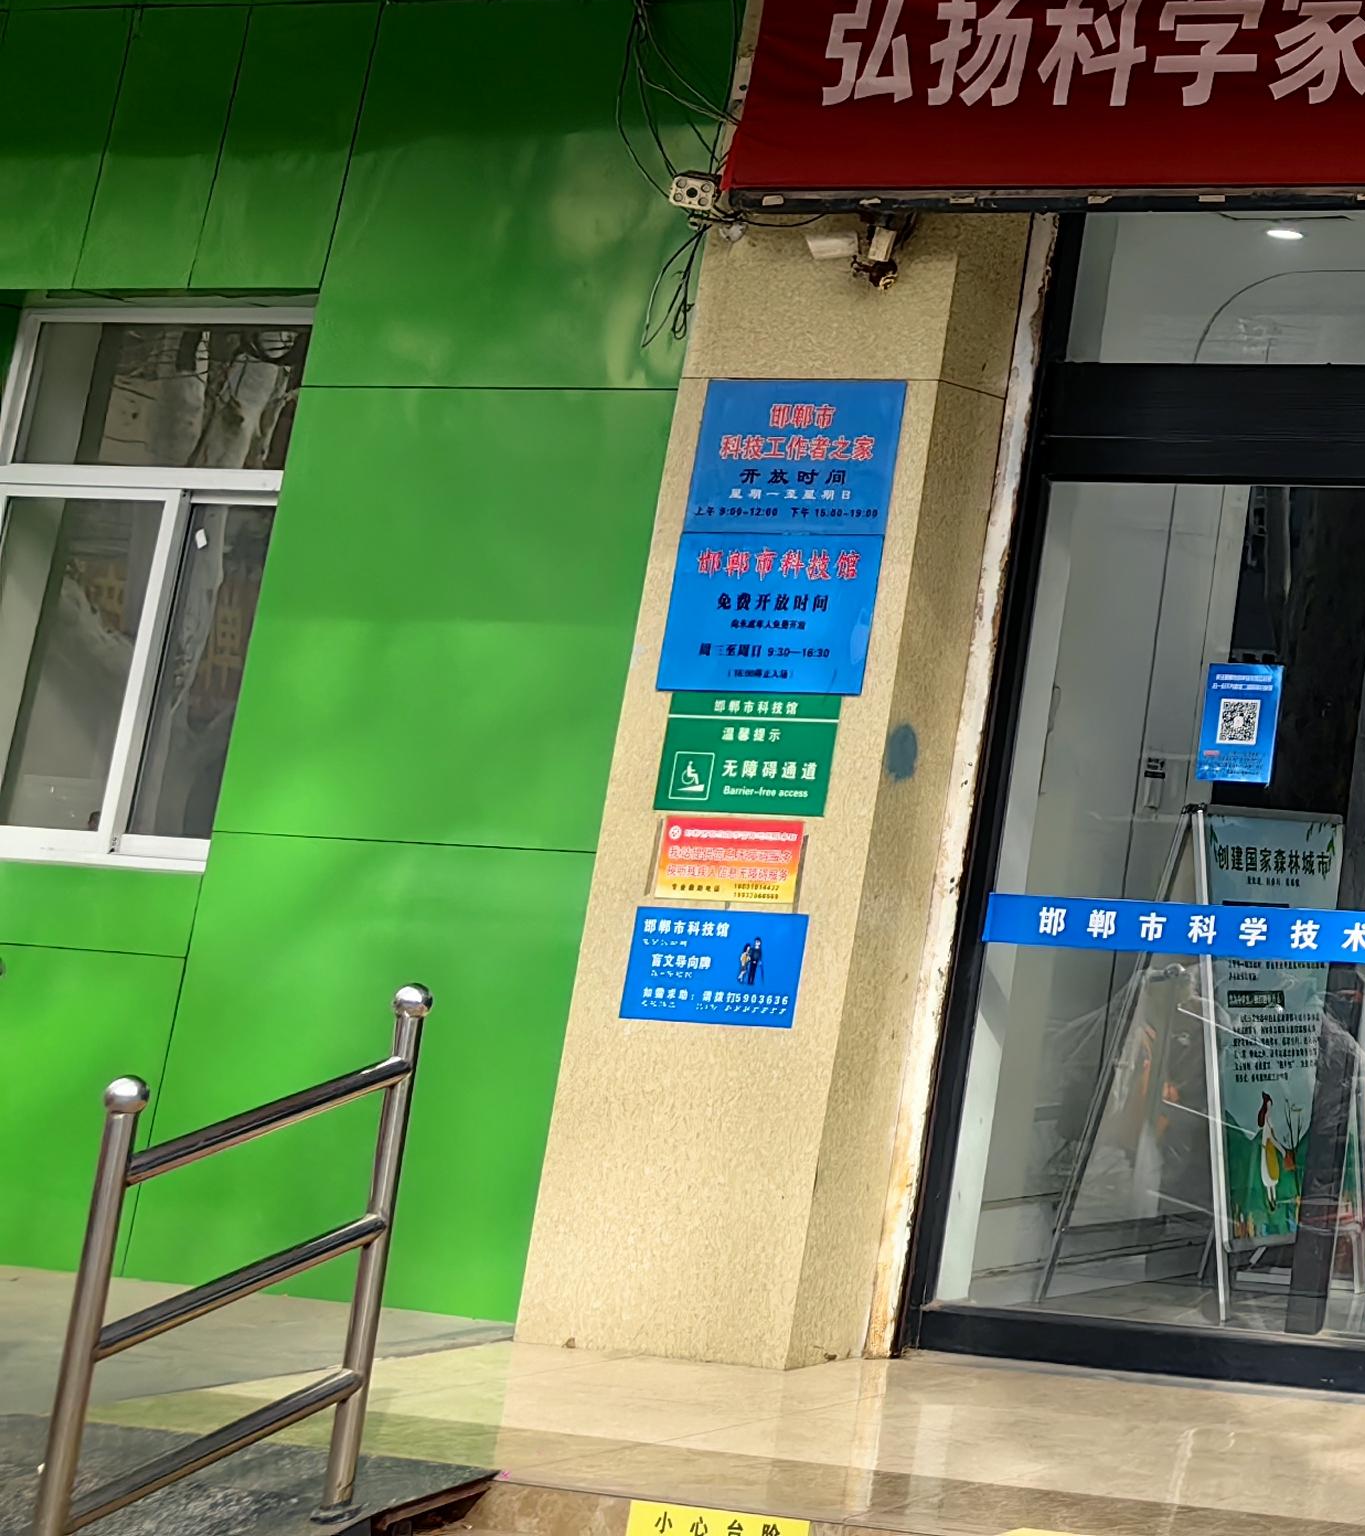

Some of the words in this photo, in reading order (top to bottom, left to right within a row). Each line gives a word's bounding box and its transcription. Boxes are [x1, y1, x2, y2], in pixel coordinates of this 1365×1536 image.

[769, 403, 837, 429] 邯郸市
[718, 435, 875, 461] 科技工作者之家
[739, 468, 847, 486] 开放时间
[696, 547, 861, 582] 邯郸市科技馆
[716, 592, 829, 613] 免费开放时间
[713, 699, 800, 716] 邯郸市科技馆
[720, 726, 783, 743] 温馨提示
[721, 759, 819, 781] 无障碍通道
[722, 785, 778, 798] Barrier-free
[778, 789, 810, 799] access
[1217, 844, 1332, 880] 创建国家森林城市
[642, 918, 731, 938] 邯郸市科技馆
[651, 953, 713, 970] 盲文导向牌
[653, 1511, 782, 1536] 小心台阶
